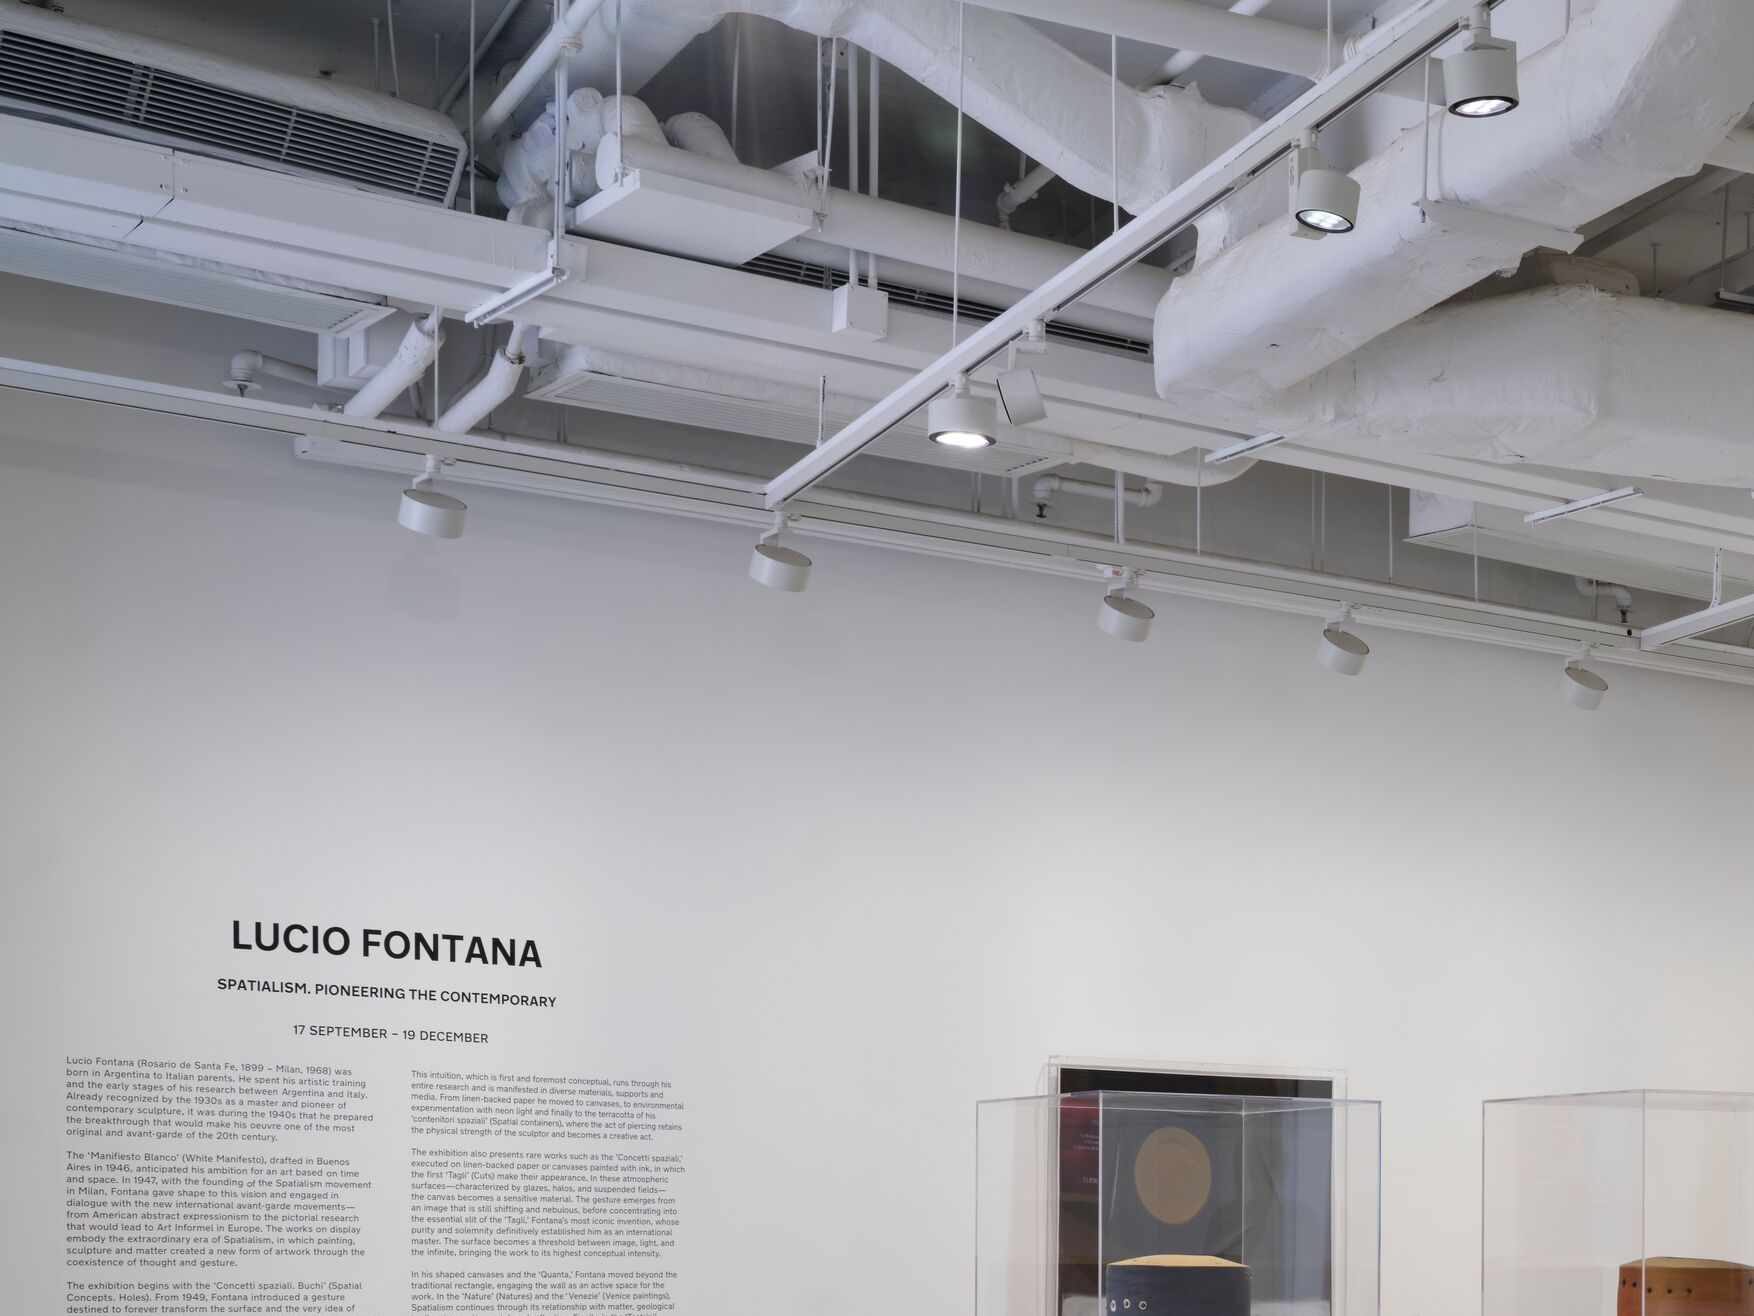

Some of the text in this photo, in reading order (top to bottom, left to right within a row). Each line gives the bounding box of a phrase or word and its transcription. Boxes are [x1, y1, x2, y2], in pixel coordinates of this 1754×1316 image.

[233, 920, 542, 968] LUCIO FONTANA
[218, 978, 556, 1007] SPATIALISM. PIONEERING THE CONTEMPORARY
[294, 1025, 305, 1034] 17
[310, 1026, 387, 1038] SEPTEMBER
[403, 1030, 415, 1040] 19
[420, 1031, 488, 1043] DECEMBER
[66, 1056, 93, 1065] Lucio
[96, 1057, 134, 1067] Fontana
[137, 1059, 177, 1070] (Rosario
[179, 1060, 191, 1069] de
[194, 1061, 221, 1070] Santa
[224, 1062, 238, 1072] Fe,
[241, 1063, 264, 1072] 1899
[276, 1064, 303, 1074] Milan,
[306, 1065, 332, 1076] 1968)
[66, 1068, 366, 1089] born in Argentina to Italian parents. He spent his artistic training
[66, 1080, 367, 1100] and the early stages of his research between Argentina and Italy.
[66, 1091, 103, 1103] Already
[106, 1093, 159, 1105] recognized
[162, 1095, 173, 1105] by
[176, 1095, 191, 1104] the
[194, 1096, 222, 1105] 1930s
[247, 1098, 279, 1107] master
[281, 1099, 298, 1108] and
[301, 1099, 335, 1111] pioneer
[338, 1101, 346, 1109] of
[66, 1103, 134, 1115] contemporary
[137, 1106, 184, 1117] sculpture,
[187, 1107, 194, 1116] it
[218, 1108, 248, 1119] during
[251, 1109, 266, 1118] the
[269, 1110, 296, 1119] 1940s
[299, 1111, 317, 1120] that
[320, 1112, 331, 1120] he
[333, 1112, 373, 1123] prepared
[423, 1203, 448, 1214] image
[450, 1204, 467, 1212] that
[468, 1204, 476, 1213] is
[477, 1204, 492, 1213] still
[493, 1205, 524, 1215] shifting
[525, 1205, 541, 1214] and
[582, 1206, 608, 1214] before
[609, 1206, 661, 1217] concentrating
[663, 1207, 677, 1215] into
[66, 1222, 86, 1231] that
[89, 1222, 118, 1231] would
[121, 1223, 141, 1231] lead
[144, 1223, 154, 1231] to
[156, 1223, 172, 1232] Art
[175, 1223, 214, 1232] Informel
[216, 1224, 225, 1232] in
[228, 1224, 263, 1235] Europe.
[265, 1225, 283, 1233] The
[285, 1225, 313, 1234] works
[329, 1226, 361, 1236] display
[66, 1246, 112, 1256] sculpture
[115, 1246, 133, 1255] and
[136, 1246, 167, 1255] matter
[170, 1247, 206, 1255] created
[239, 1247, 260, 1256] form
[263, 1247, 273, 1256] of
[275, 1248, 311, 1256] artwork
[313, 1248, 348, 1259] through
[351, 1249, 365, 1257] the
[66, 1258, 238, 1269] coexistence of thought and gesture.
[411, 1281, 453, 1289] traditional
[496, 1281, 533, 1291] engaging
[534, 1281, 548, 1289] the
[550, 1281, 566, 1289] wall
[590, 1281, 615, 1289] active
[614, 1283, 638, 1291] space
[639, 1281, 652, 1289] for
[651, 1281, 665, 1289] the
[67, 1304, 355, 1314] destined to forever transform the surface and the very idea of
